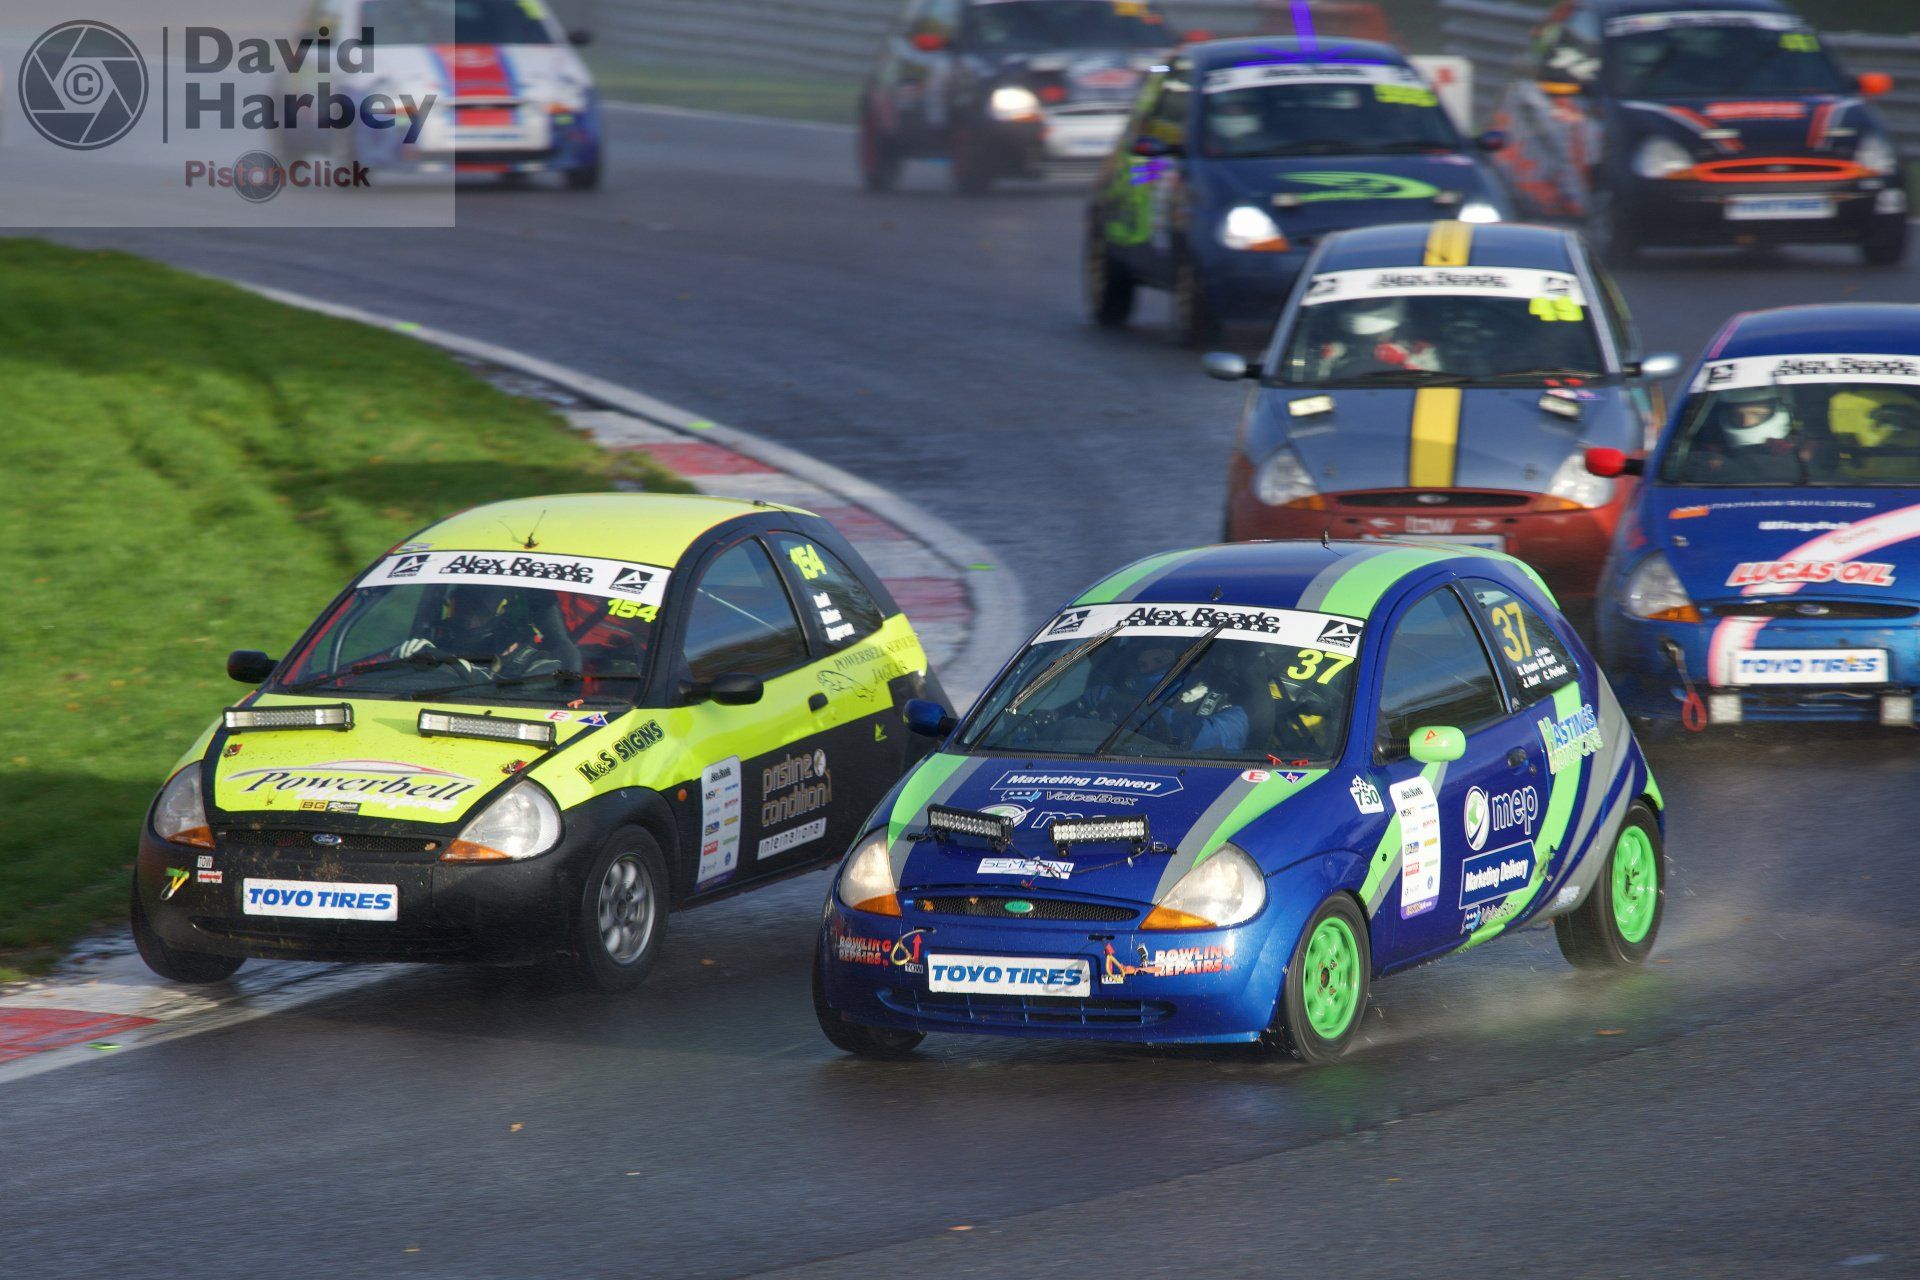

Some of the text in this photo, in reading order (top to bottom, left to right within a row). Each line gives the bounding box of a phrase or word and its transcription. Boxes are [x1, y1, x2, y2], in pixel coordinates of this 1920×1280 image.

[439, 566, 594, 584] MOTORSPORT
[446, 555, 594, 577] Alex Reade
[1731, 562, 1889, 584] LUCAS OIL
[608, 599, 660, 622] 154
[1125, 606, 1280, 626] Alex Reade
[1491, 601, 1533, 662] 37
[1287, 649, 1355, 685] 37
[1741, 657, 1880, 674] TOYO TIRES
[613, 719, 665, 762] SIGNS
[243, 772, 476, 801] Powerbell
[1007, 775, 1162, 791] Marketing Delivery
[302, 801, 326, 810] BG
[761, 783, 826, 828] condition
[1047, 791, 1139, 805] VoiceBox
[1354, 789, 1380, 806] 750
[1492, 785, 1539, 835] mep
[1465, 859, 1528, 892] Marketing Delivery
[249, 888, 393, 911] TOYO TIRES
[932, 965, 1083, 986] TOYO TIRES
